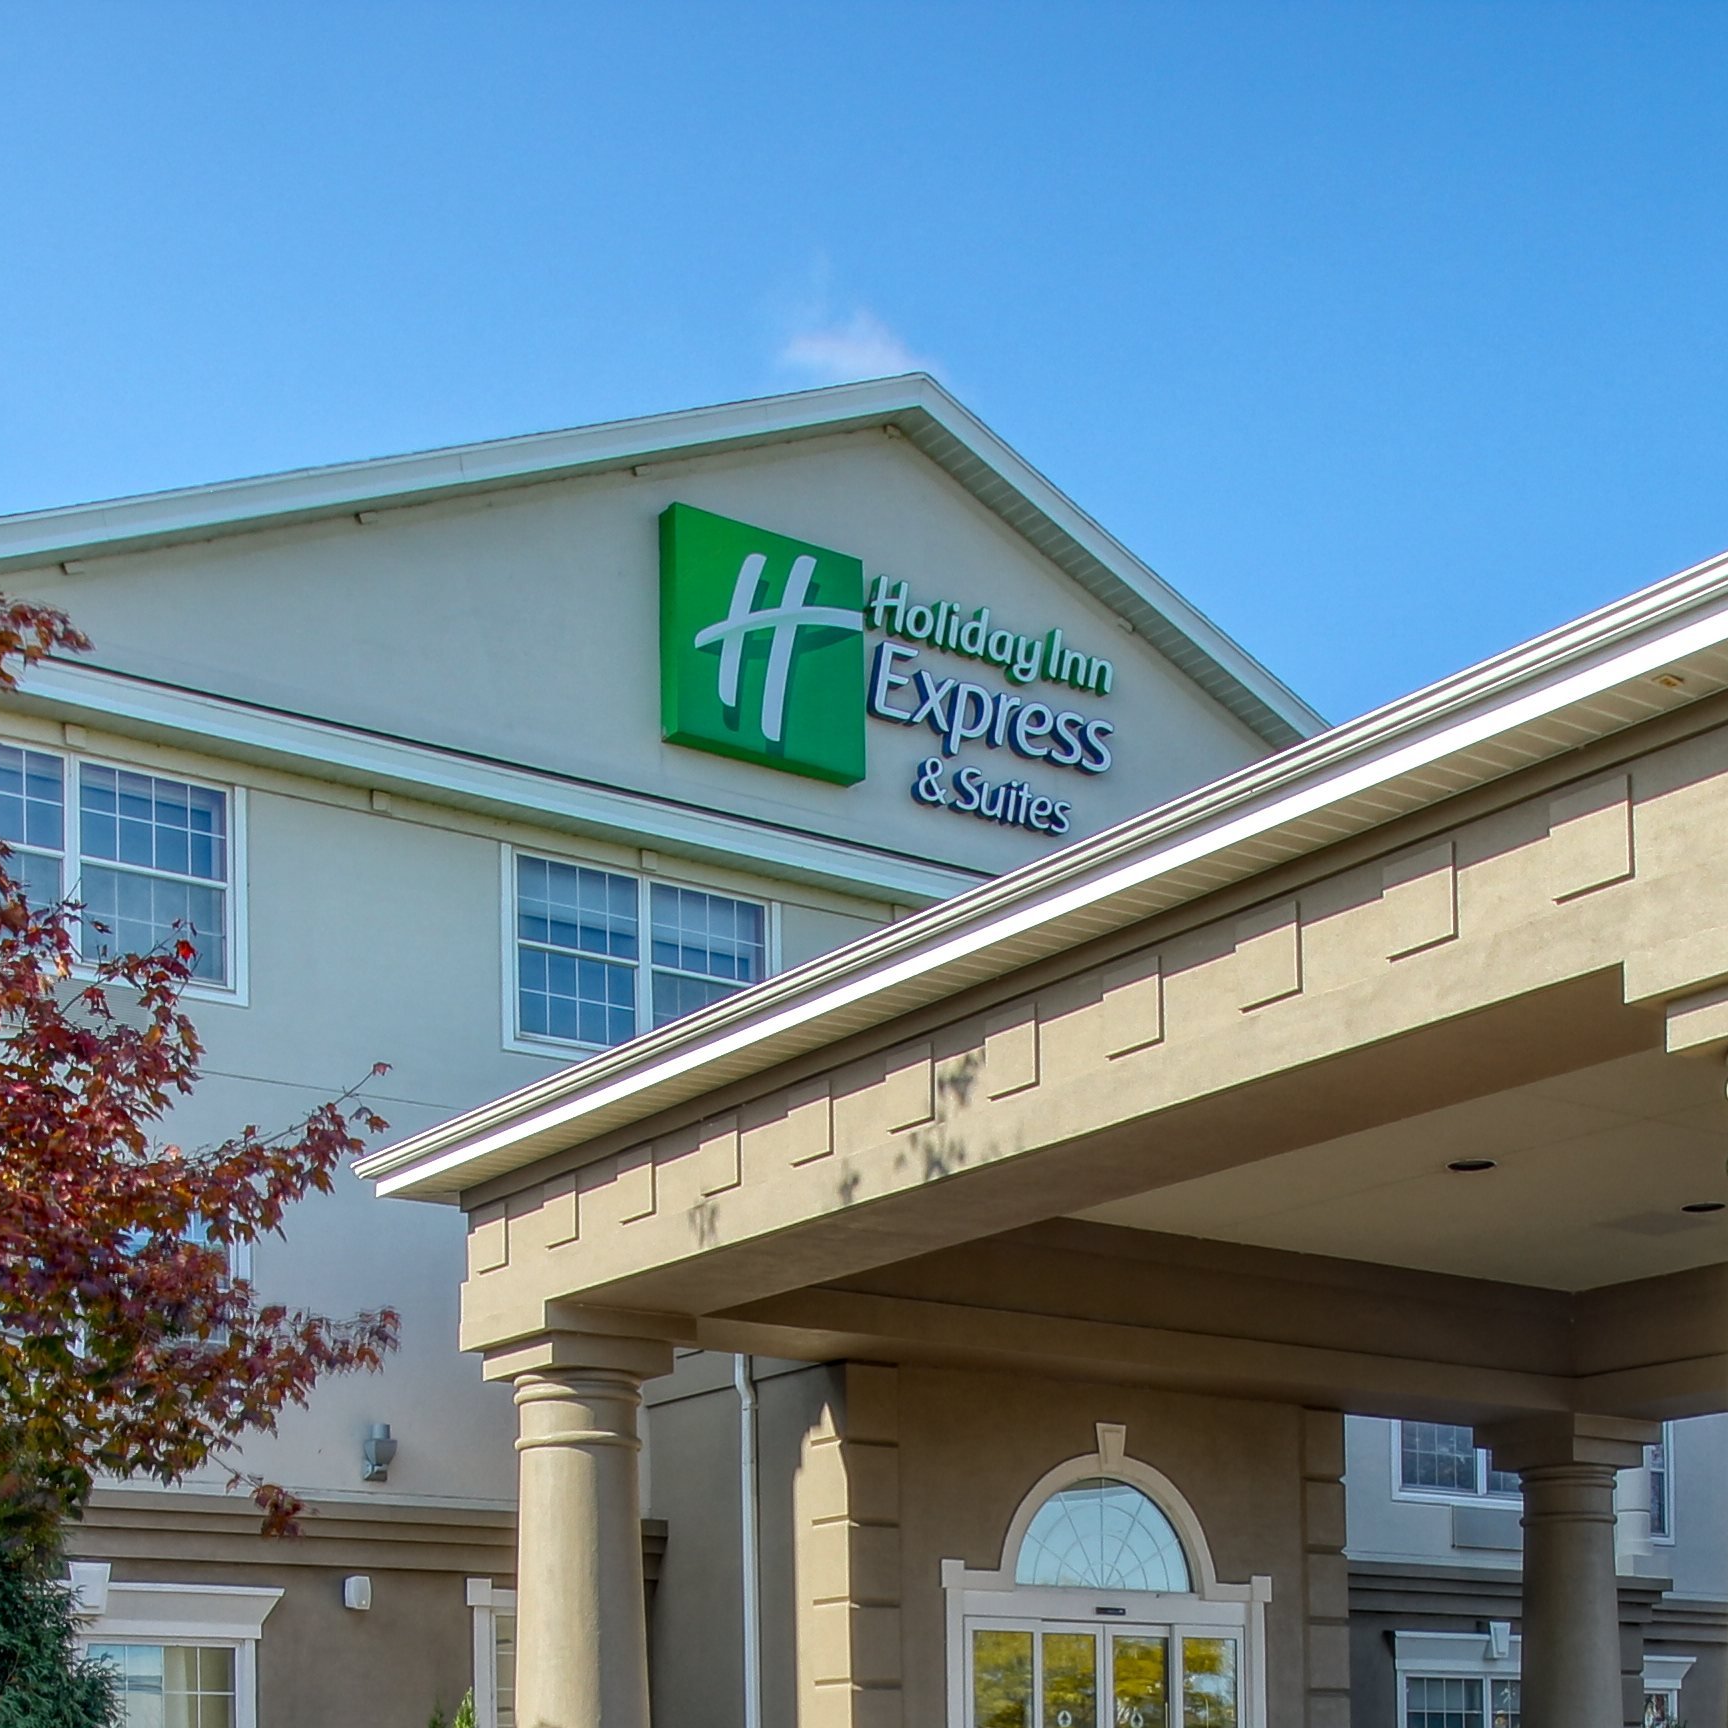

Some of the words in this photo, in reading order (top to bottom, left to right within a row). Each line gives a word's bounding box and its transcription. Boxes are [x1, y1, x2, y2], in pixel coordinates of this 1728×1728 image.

[868, 574, 1043, 684] Holiday
[1046, 628, 1114, 695] Inn
[869, 641, 1114, 774] Express
[914, 757, 948, 805] &
[953, 766, 1072, 835] Suites
